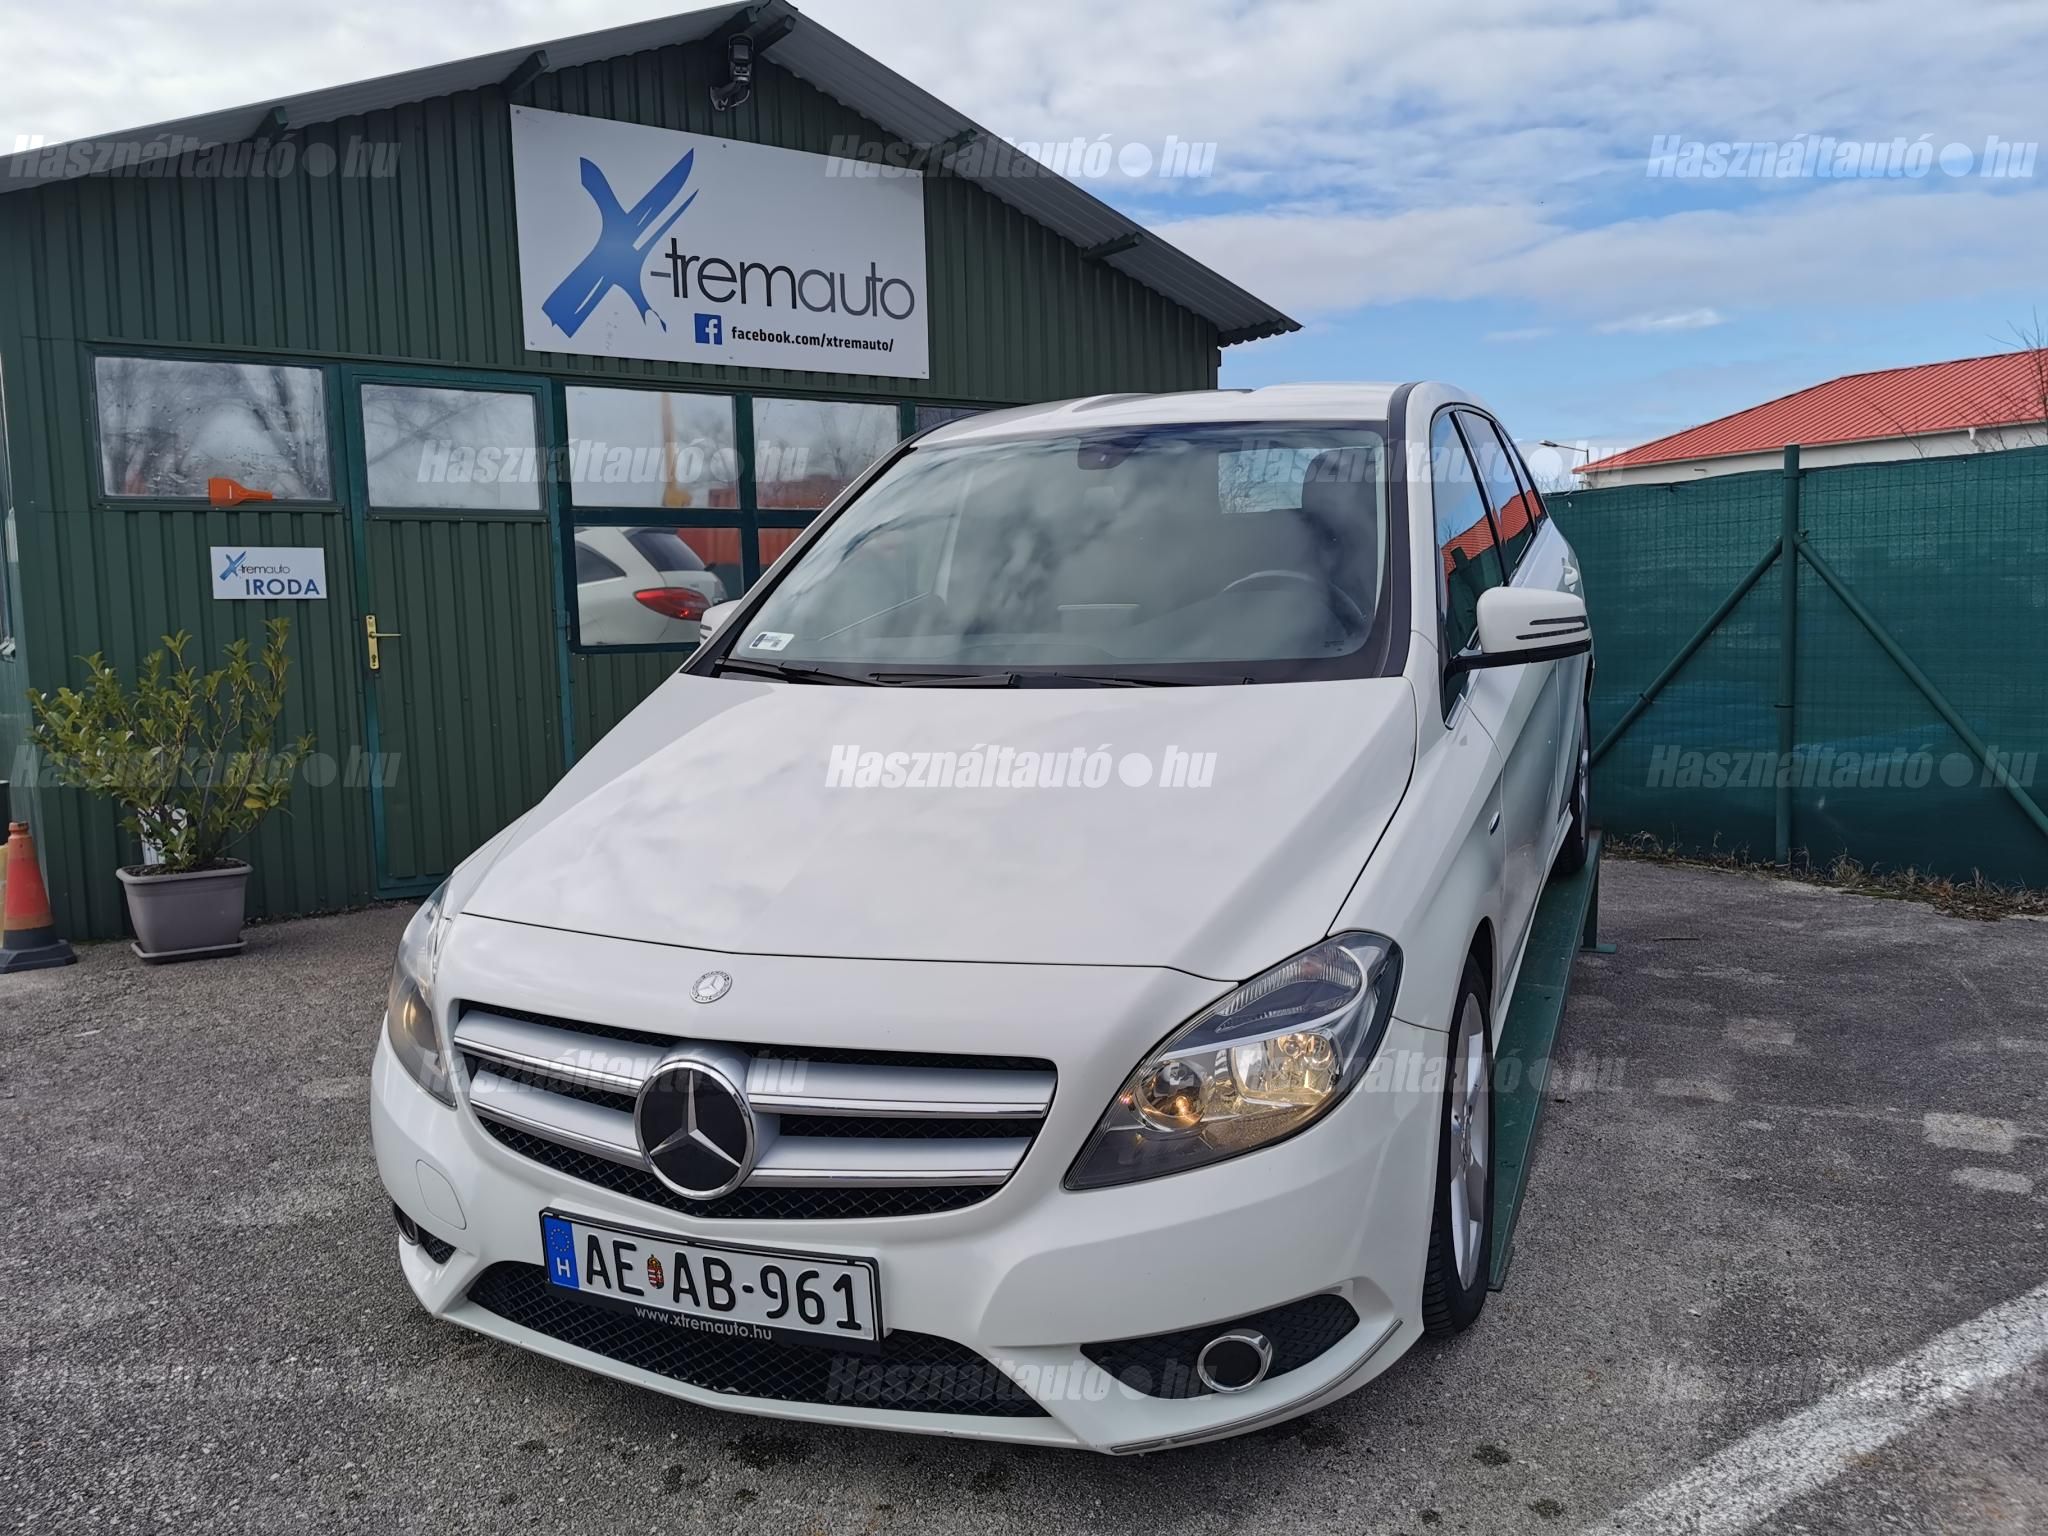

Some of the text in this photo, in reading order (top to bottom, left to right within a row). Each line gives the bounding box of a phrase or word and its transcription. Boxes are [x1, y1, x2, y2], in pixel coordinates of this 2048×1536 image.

[731, 326, 894, 353] facebook.com/xtremauto/
[246, 578, 320, 595] IRODA
[556, 1234, 862, 1331] H AE AB-961
[634, 1305, 773, 1341] www.xtremauto.hu
